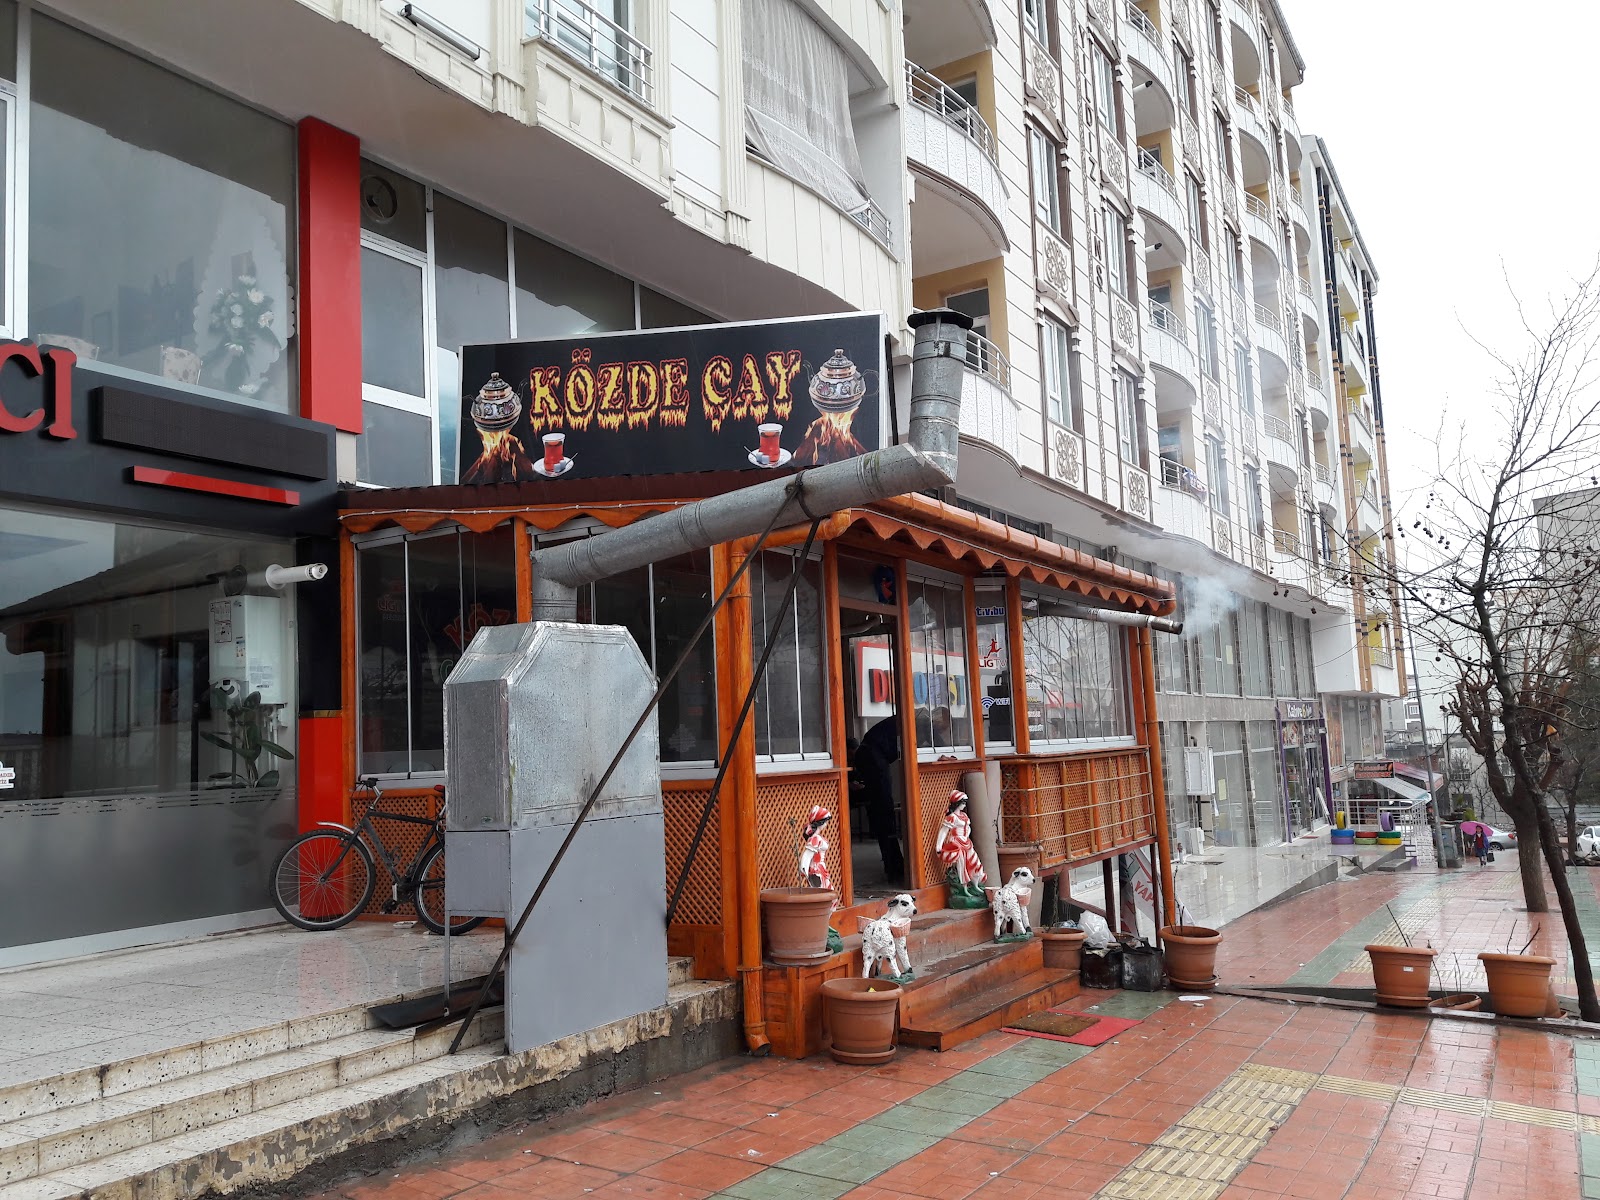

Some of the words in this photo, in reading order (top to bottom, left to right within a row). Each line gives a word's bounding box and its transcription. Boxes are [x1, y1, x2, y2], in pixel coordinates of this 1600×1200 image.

[1078, 24, 1096, 181] YILDIZ
[530, 348, 690, 437] KÖZDE
[702, 349, 801, 436] ÇAY
[976, 606, 1005, 616] tivibu
